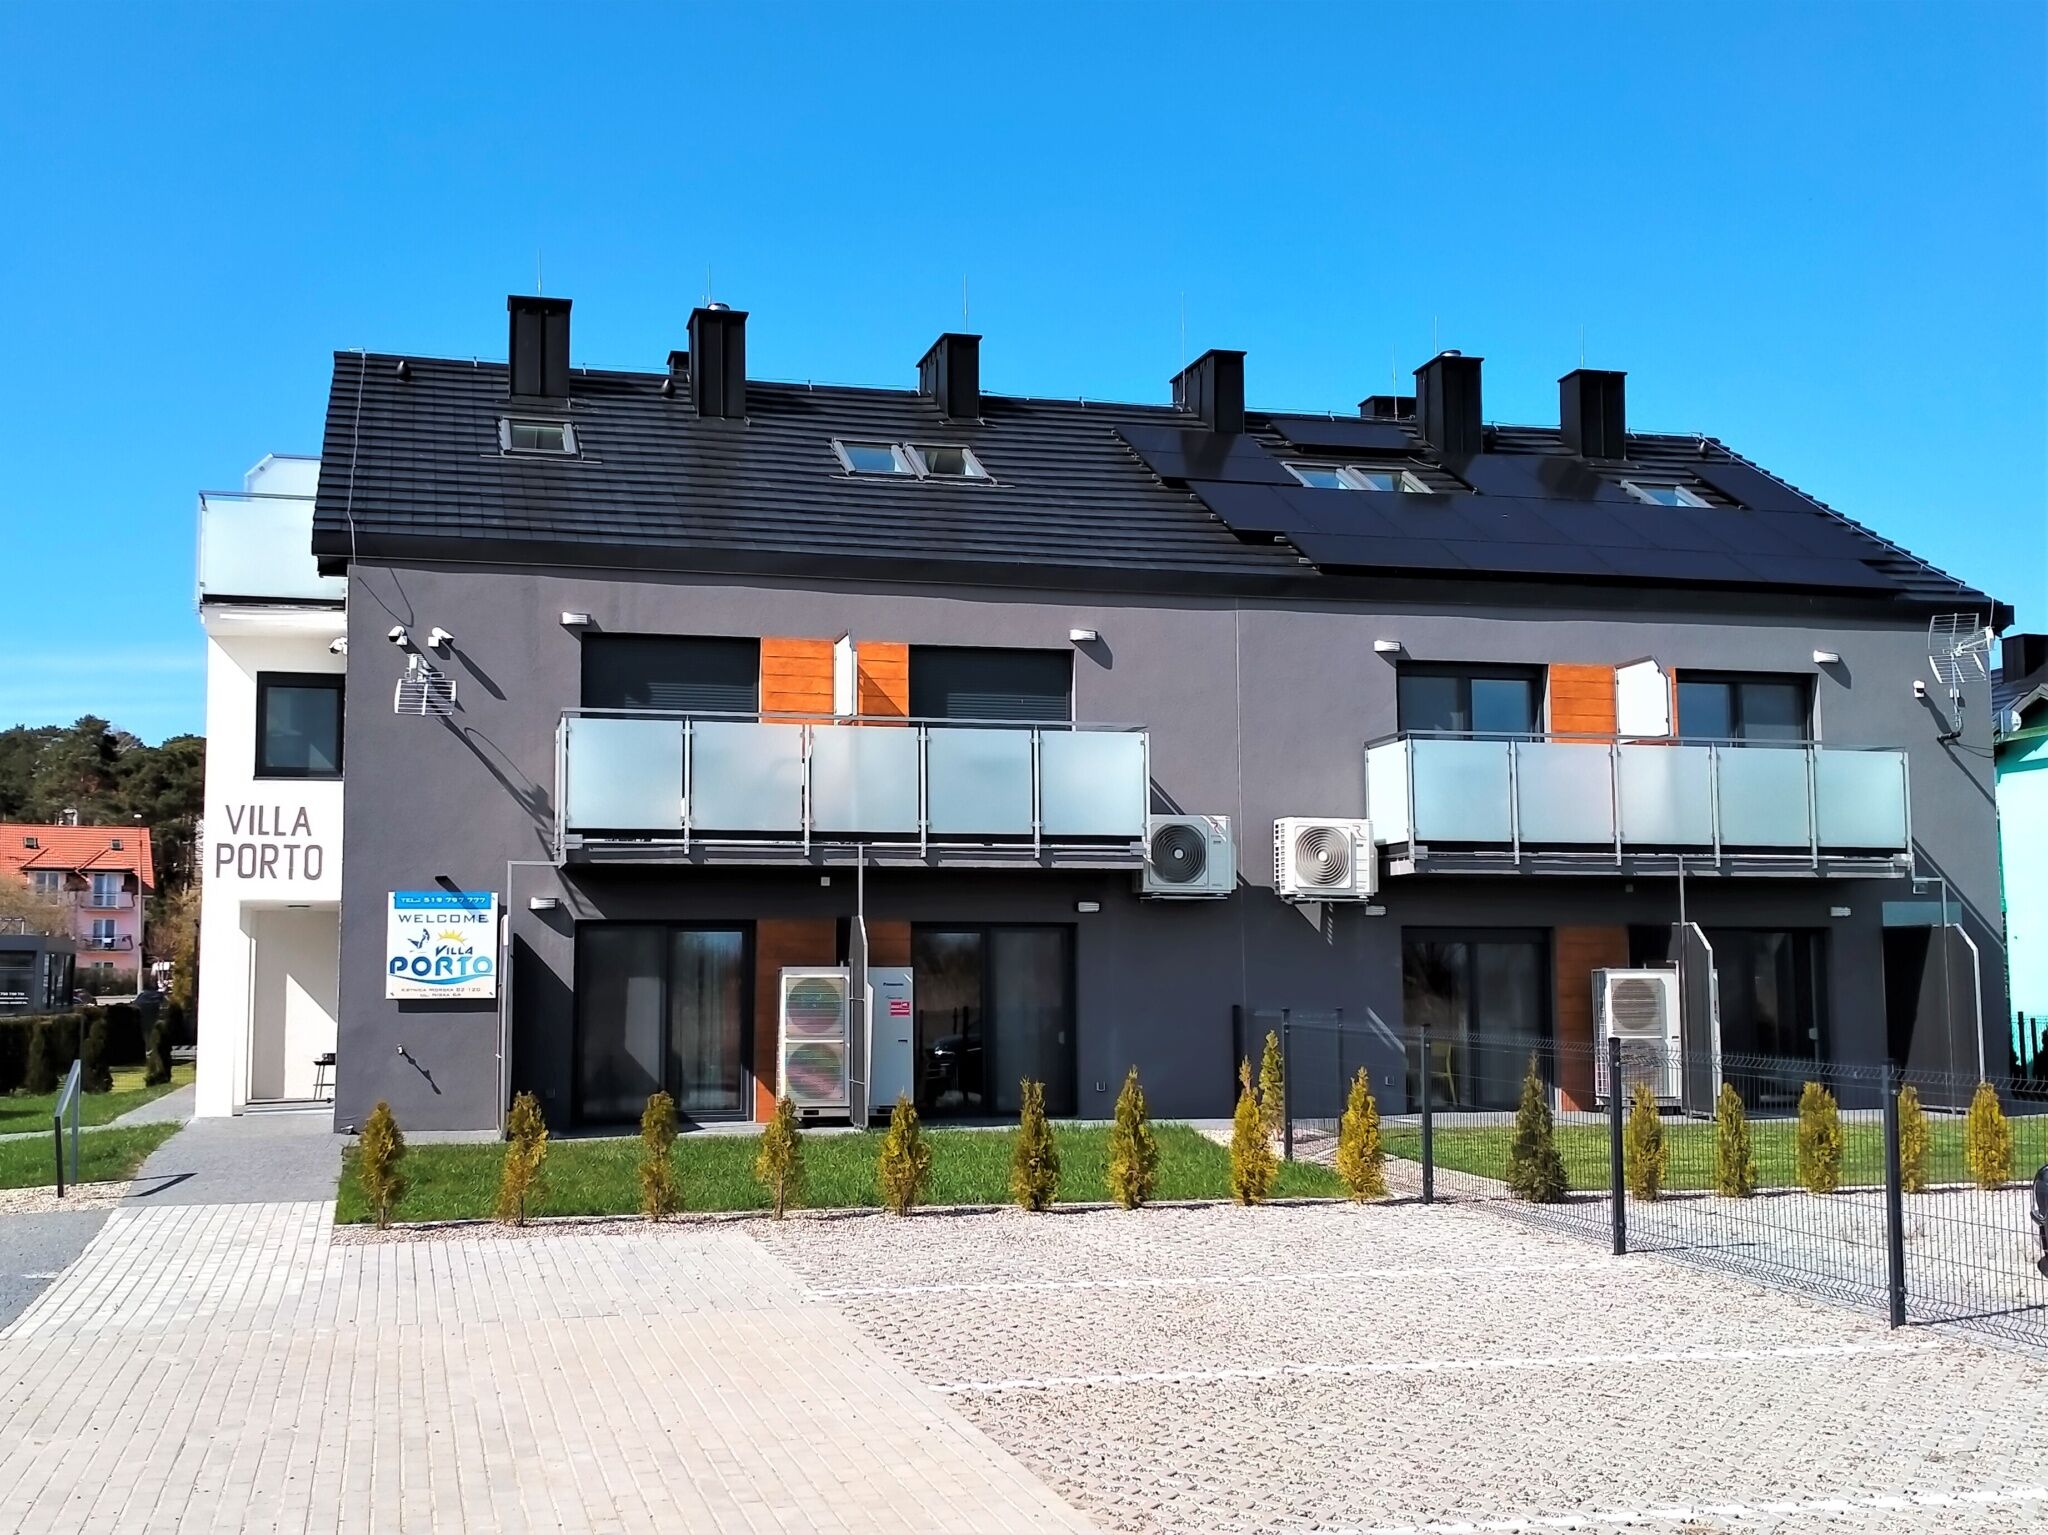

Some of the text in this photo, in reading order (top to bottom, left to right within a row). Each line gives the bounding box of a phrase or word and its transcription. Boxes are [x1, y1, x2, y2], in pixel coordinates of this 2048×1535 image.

[225, 805, 312, 836] VILLA
[216, 843, 323, 880] PORTO
[399, 914, 489, 923] WELCOME
[390, 956, 493, 976] PORTO
